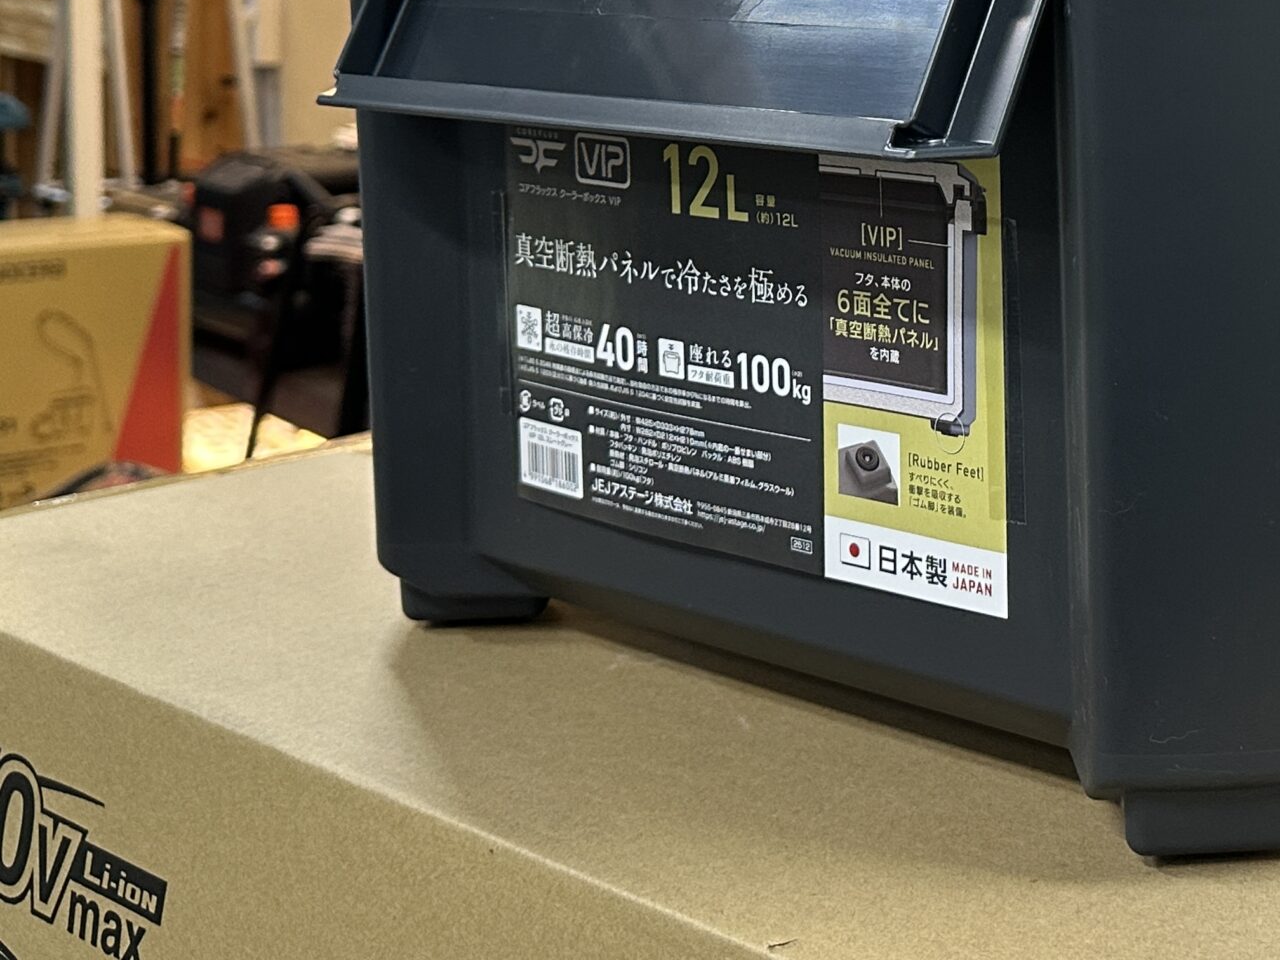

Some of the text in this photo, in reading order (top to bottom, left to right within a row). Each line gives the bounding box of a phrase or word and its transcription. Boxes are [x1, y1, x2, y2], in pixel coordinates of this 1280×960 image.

[580, 141, 625, 179] VIP
[518, 182, 622, 207] コアフラックス クーラーボックス VIP
[663, 143, 750, 221] 12L
[756, 193, 776, 208] 容量
[514, 232, 808, 308] 真空断熱パネルで冷たさを極める
[829, 247, 936, 270] VACUUM INSULATED PANEL
[855, 271, 912, 292] フタ、本体の
[837, 288, 930, 325] 6面全てに
[829, 316, 940, 352] 「真空断熱パネル」
[596, 323, 635, 372] 40
[689, 343, 732, 368] 座れる
[869, 346, 901, 365] を内蔵
[690, 368, 731, 386] フタ耐荷重
[591, 478, 694, 515] JEJアステージ株式会社
[908, 484, 961, 505] 衝撃を吸収する
[879, 545, 948, 588] 日本製
[951, 561, 992, 580] MADE IN
[952, 577, 992, 597] JAPAN
